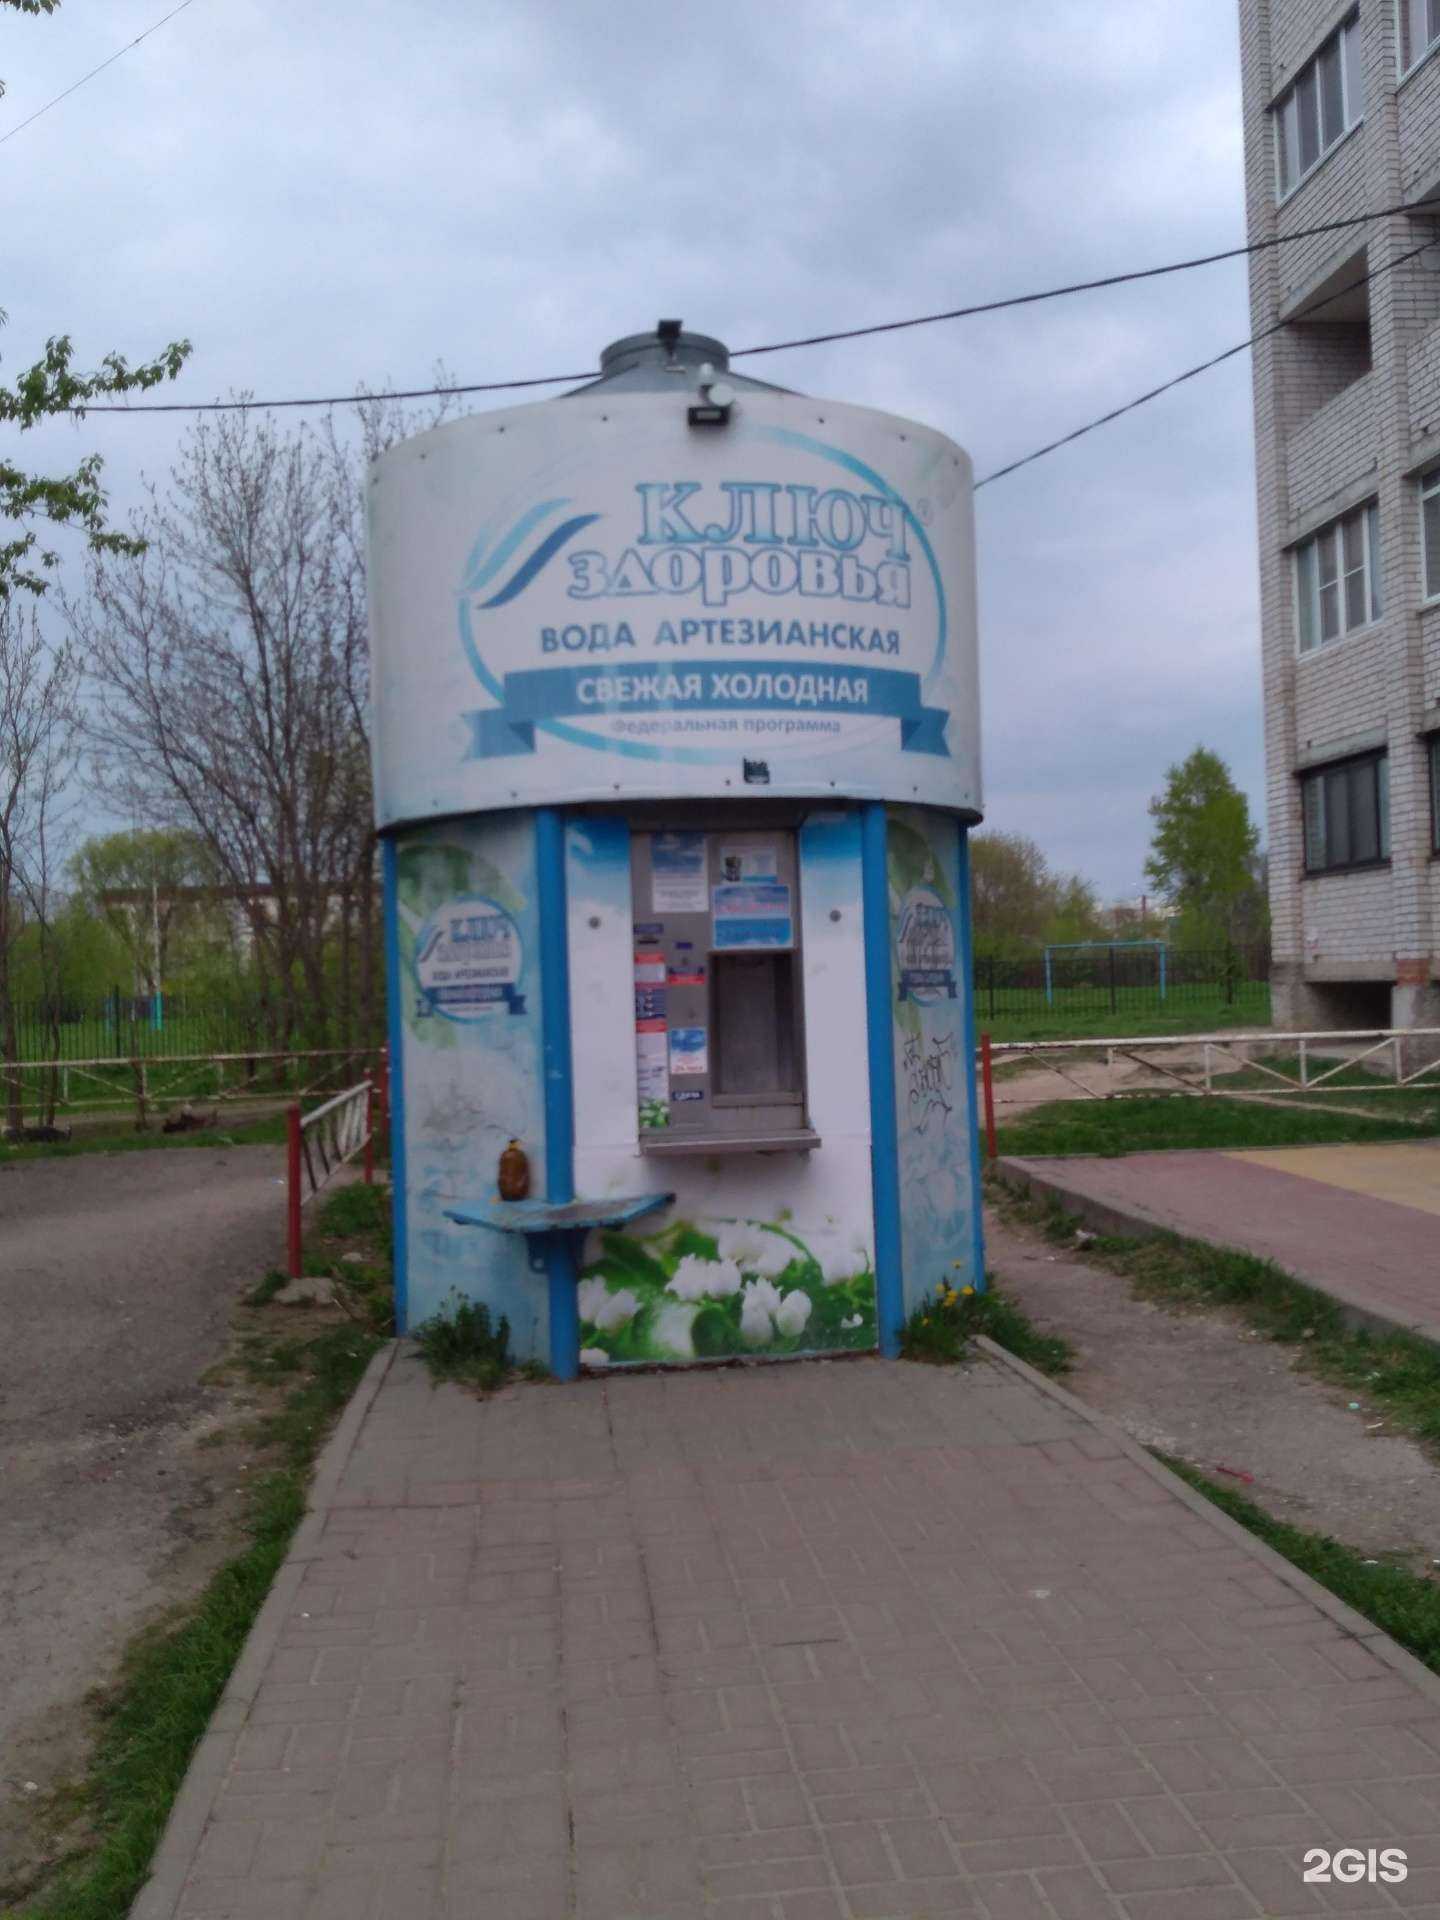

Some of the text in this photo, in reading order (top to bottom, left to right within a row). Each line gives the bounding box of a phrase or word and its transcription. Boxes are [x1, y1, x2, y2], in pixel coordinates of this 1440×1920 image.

[636, 482, 911, 561] КЛЮЧ
[541, 619, 901, 655] ВОДА АРТЕЗИАНСКАЯ
[577, 672, 868, 706] СВЕЖАЯ ХОЛОДНАЯ
[613, 716, 841, 736] Федеальная программа
